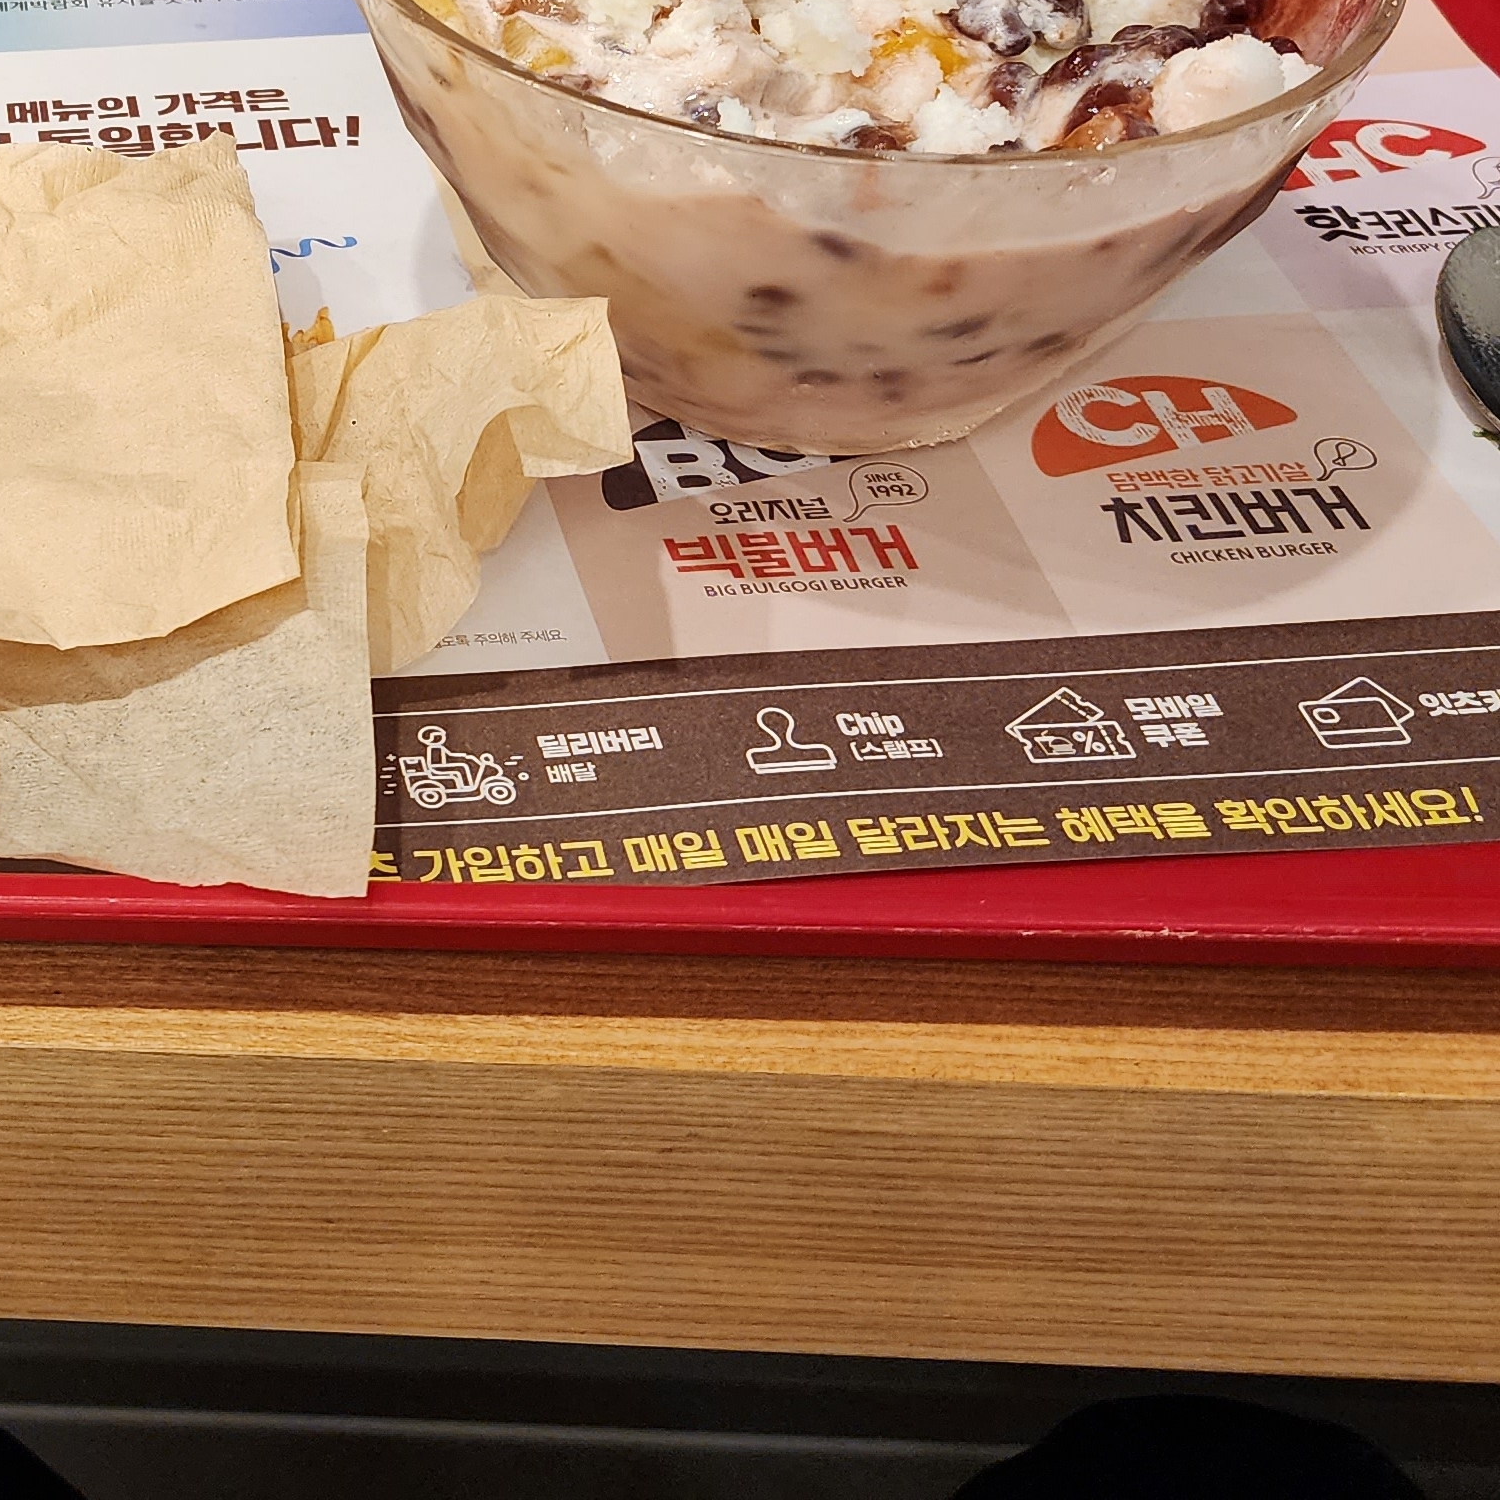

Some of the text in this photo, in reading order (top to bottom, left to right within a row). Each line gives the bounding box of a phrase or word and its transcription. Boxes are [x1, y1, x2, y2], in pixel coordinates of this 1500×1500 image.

[5, 95, 141, 124] 메뉴의
[154, 88, 290, 116] 가격은
[1296, 122, 1453, 187] HC
[1349, 244, 1386, 255] HOT
[1389, 242, 1441, 255] CRISPY
[1055, 383, 1256, 451] CH
[863, 471, 905, 484] SINCE
[1105, 461, 1313, 493] 담백한 닭고기살
[866, 483, 918, 499] 1992
[708, 496, 833, 525] 오리지널
[1100, 485, 1372, 544] 치킨버거
[662, 524, 920, 579] 빅불버거
[1170, 541, 1339, 566] CHICKEN BURGER
[703, 575, 909, 598] BIG BULGOGI BURGER
[473, 631, 518, 647] 주의해
[1123, 693, 1225, 721] 모바일
[834, 711, 905, 738] Chip
[1139, 722, 1210, 749] 쿠폰
[536, 726, 663, 759] 딜리버리
[849, 737, 944, 762] (스탬프)
[545, 762, 598, 784] 배달
[413, 840, 615, 884] 가입하고
[622, 829, 728, 873] 매일
[734, 820, 842, 863] 매일
[846, 811, 1051, 857] 달라지는
[1054, 800, 1212, 844] 혜택을
[1213, 786, 1484, 836] 확인하세요!
